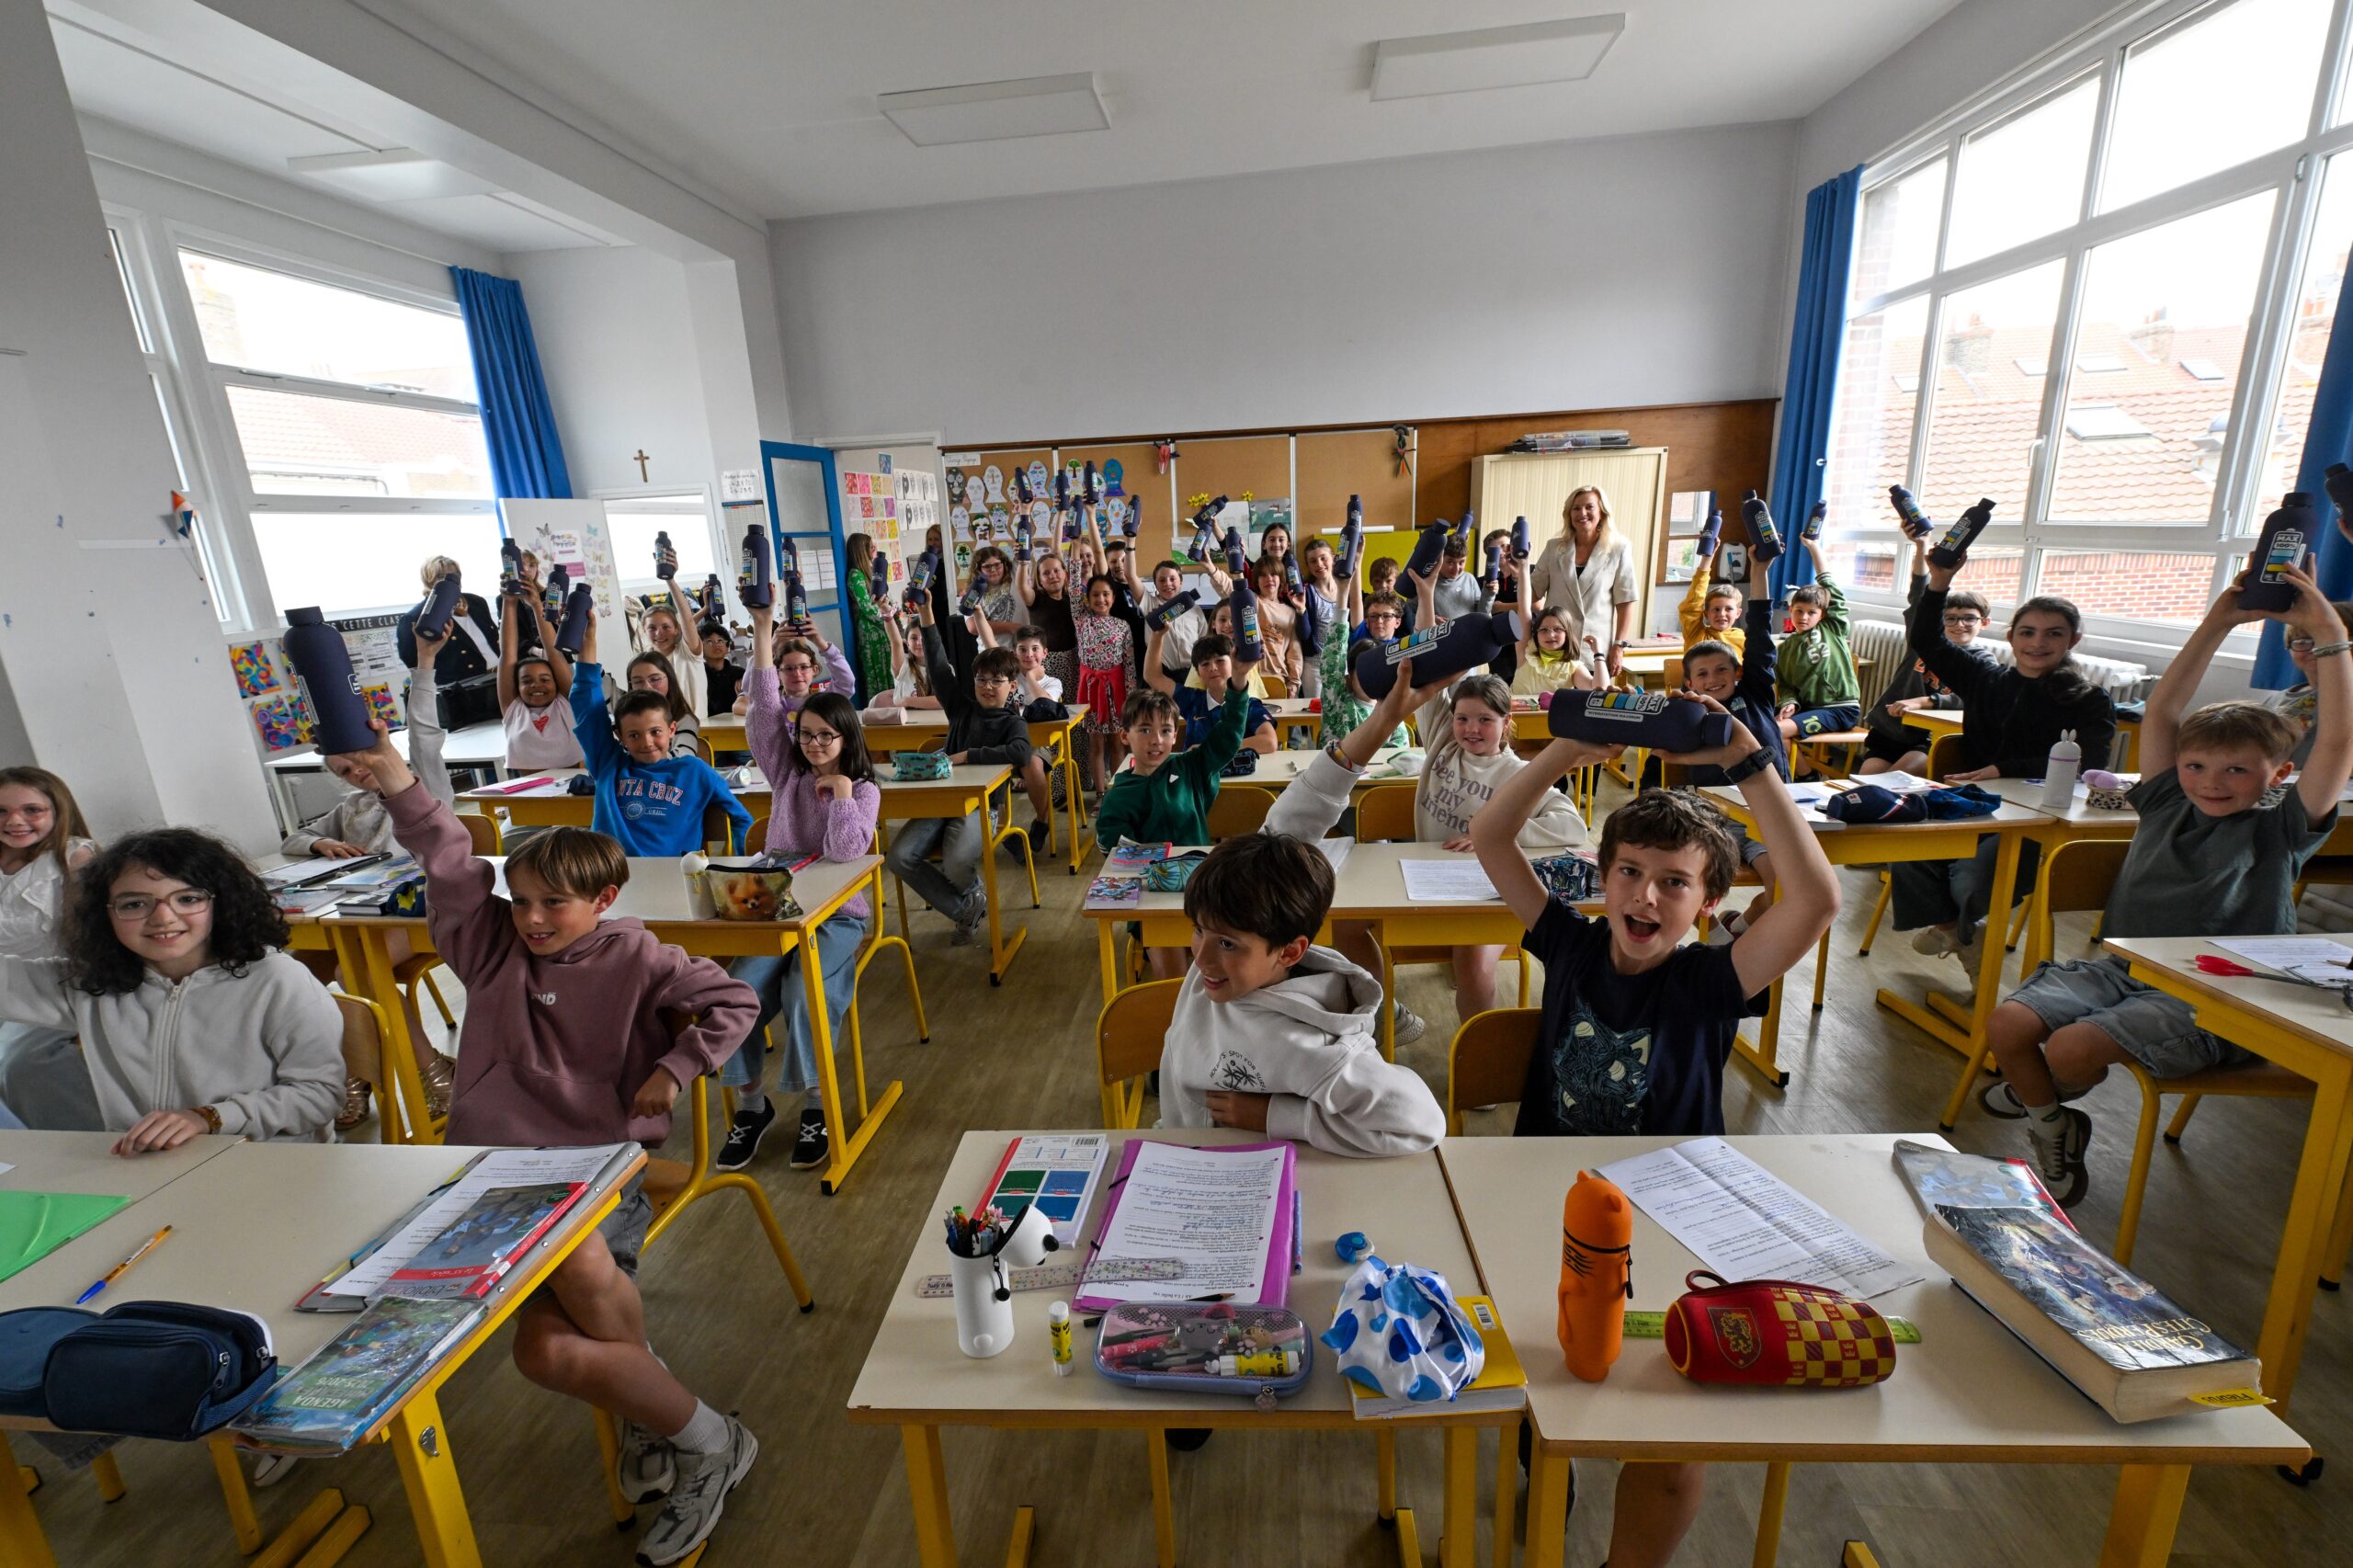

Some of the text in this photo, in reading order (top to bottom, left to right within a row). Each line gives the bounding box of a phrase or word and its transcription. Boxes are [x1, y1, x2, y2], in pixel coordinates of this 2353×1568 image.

[343, 619, 373, 631] CETTE
[649, 781, 684, 806] CRUZ
[1452, 778, 1494, 801] you
[1435, 786, 1465, 812] my
[1228, 1050, 1243, 1059] SPOT
[292, 1395, 351, 1410] AGENDA
[2200, 1393, 2254, 1403] Fleurus
